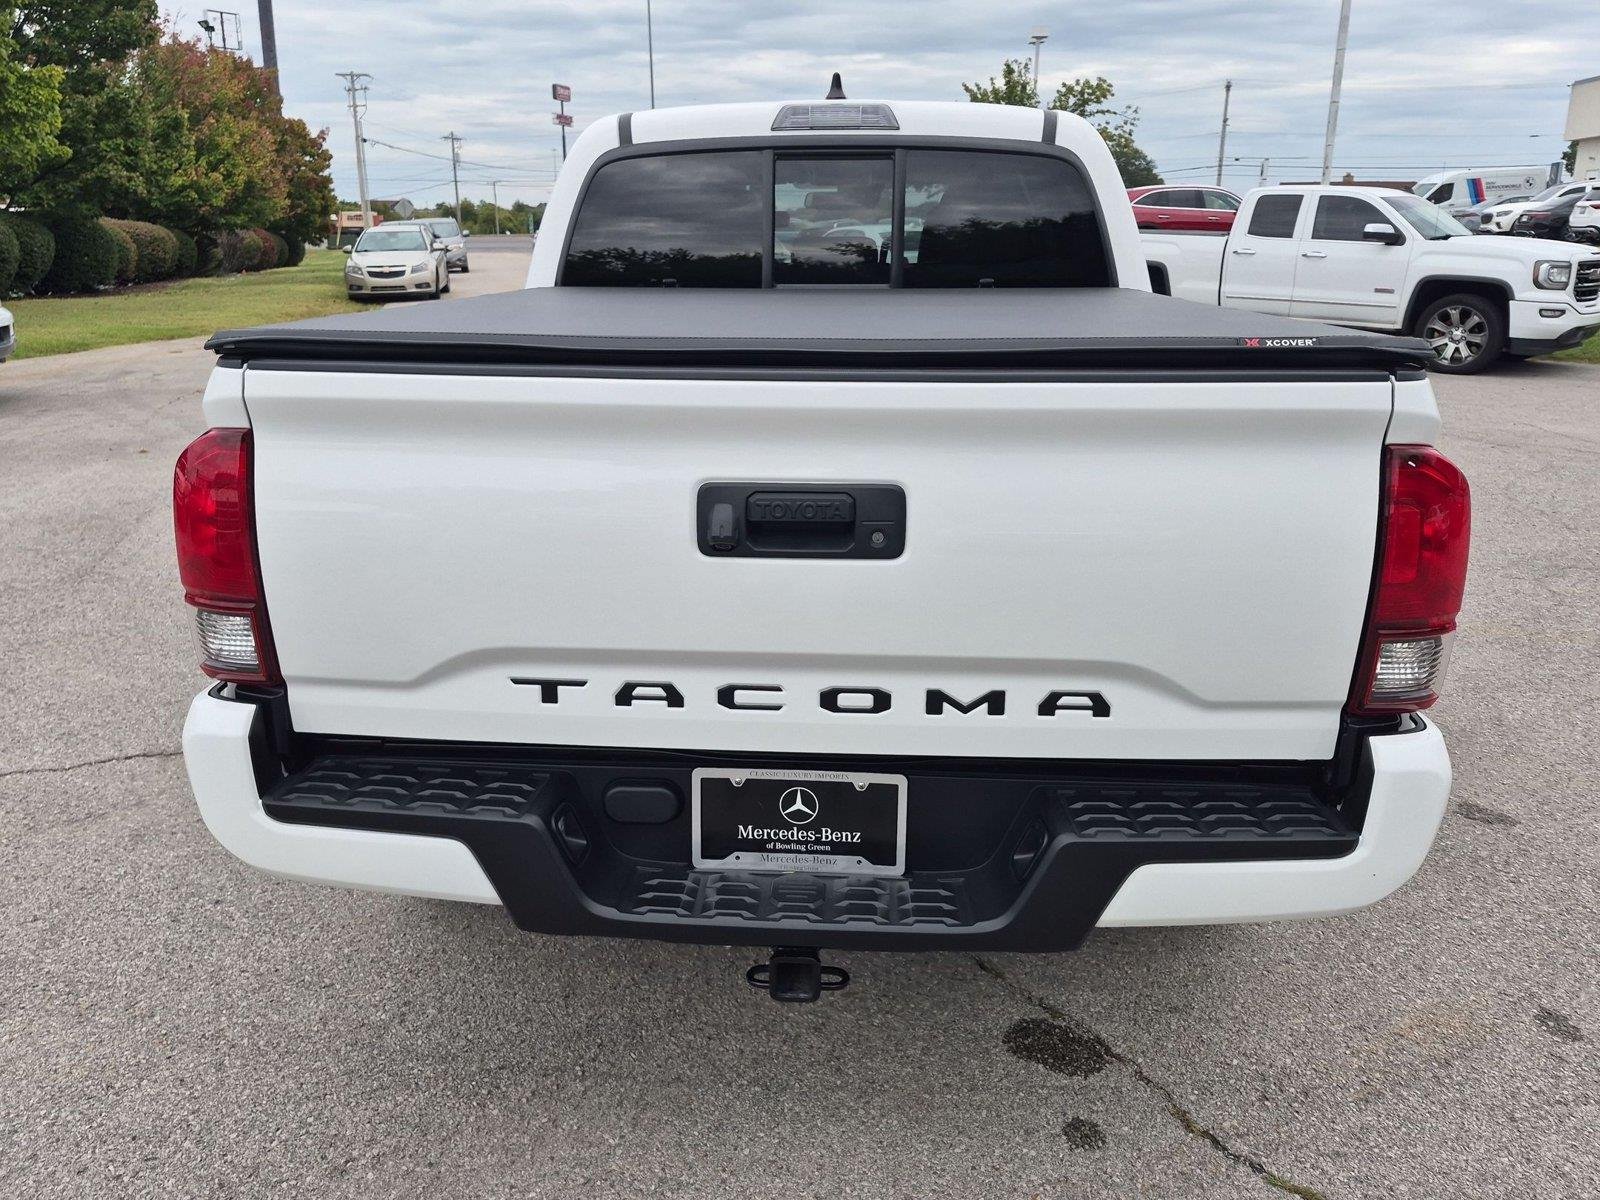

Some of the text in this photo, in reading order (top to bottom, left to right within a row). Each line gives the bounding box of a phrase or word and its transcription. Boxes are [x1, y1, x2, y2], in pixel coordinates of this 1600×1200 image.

[756, 500, 846, 520] TOYOTA
[509, 677, 1112, 718] TACOMA
[815, 772, 850, 780] IMPORTS
[737, 825, 861, 843] Mercedes-Benz
[776, 842, 806, 851] Bowling
[807, 843, 831, 851] Green
[760, 854, 838, 866] Mercedes-Benz
